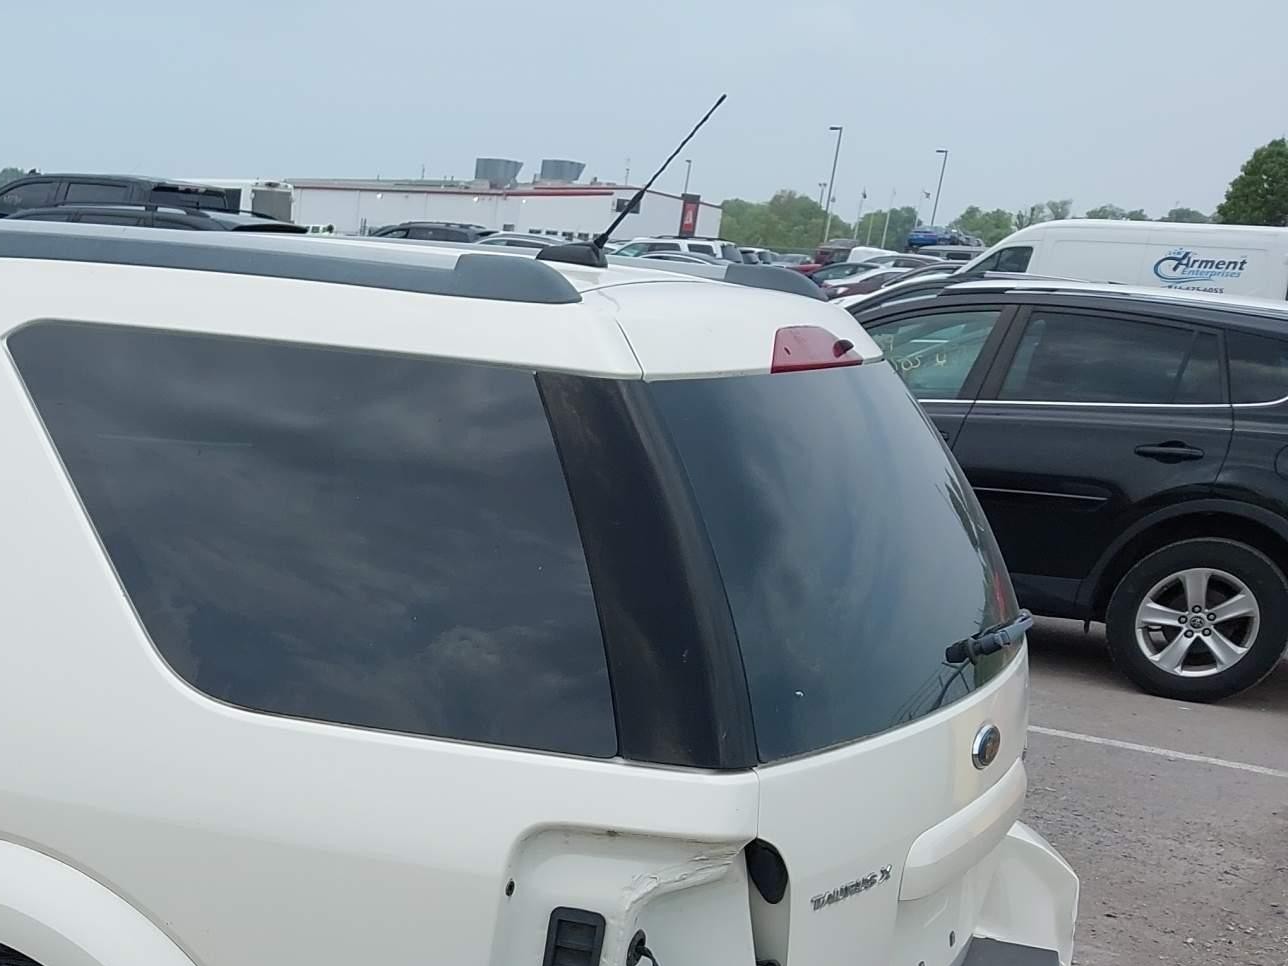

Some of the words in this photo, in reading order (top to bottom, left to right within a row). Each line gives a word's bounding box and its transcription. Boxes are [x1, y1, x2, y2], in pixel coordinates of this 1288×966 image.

[1172, 251, 1248, 272] Arment
[1181, 267, 1241, 279] Enterprises
[810, 872, 878, 911] TAURUS
[878, 864, 892, 884] X
